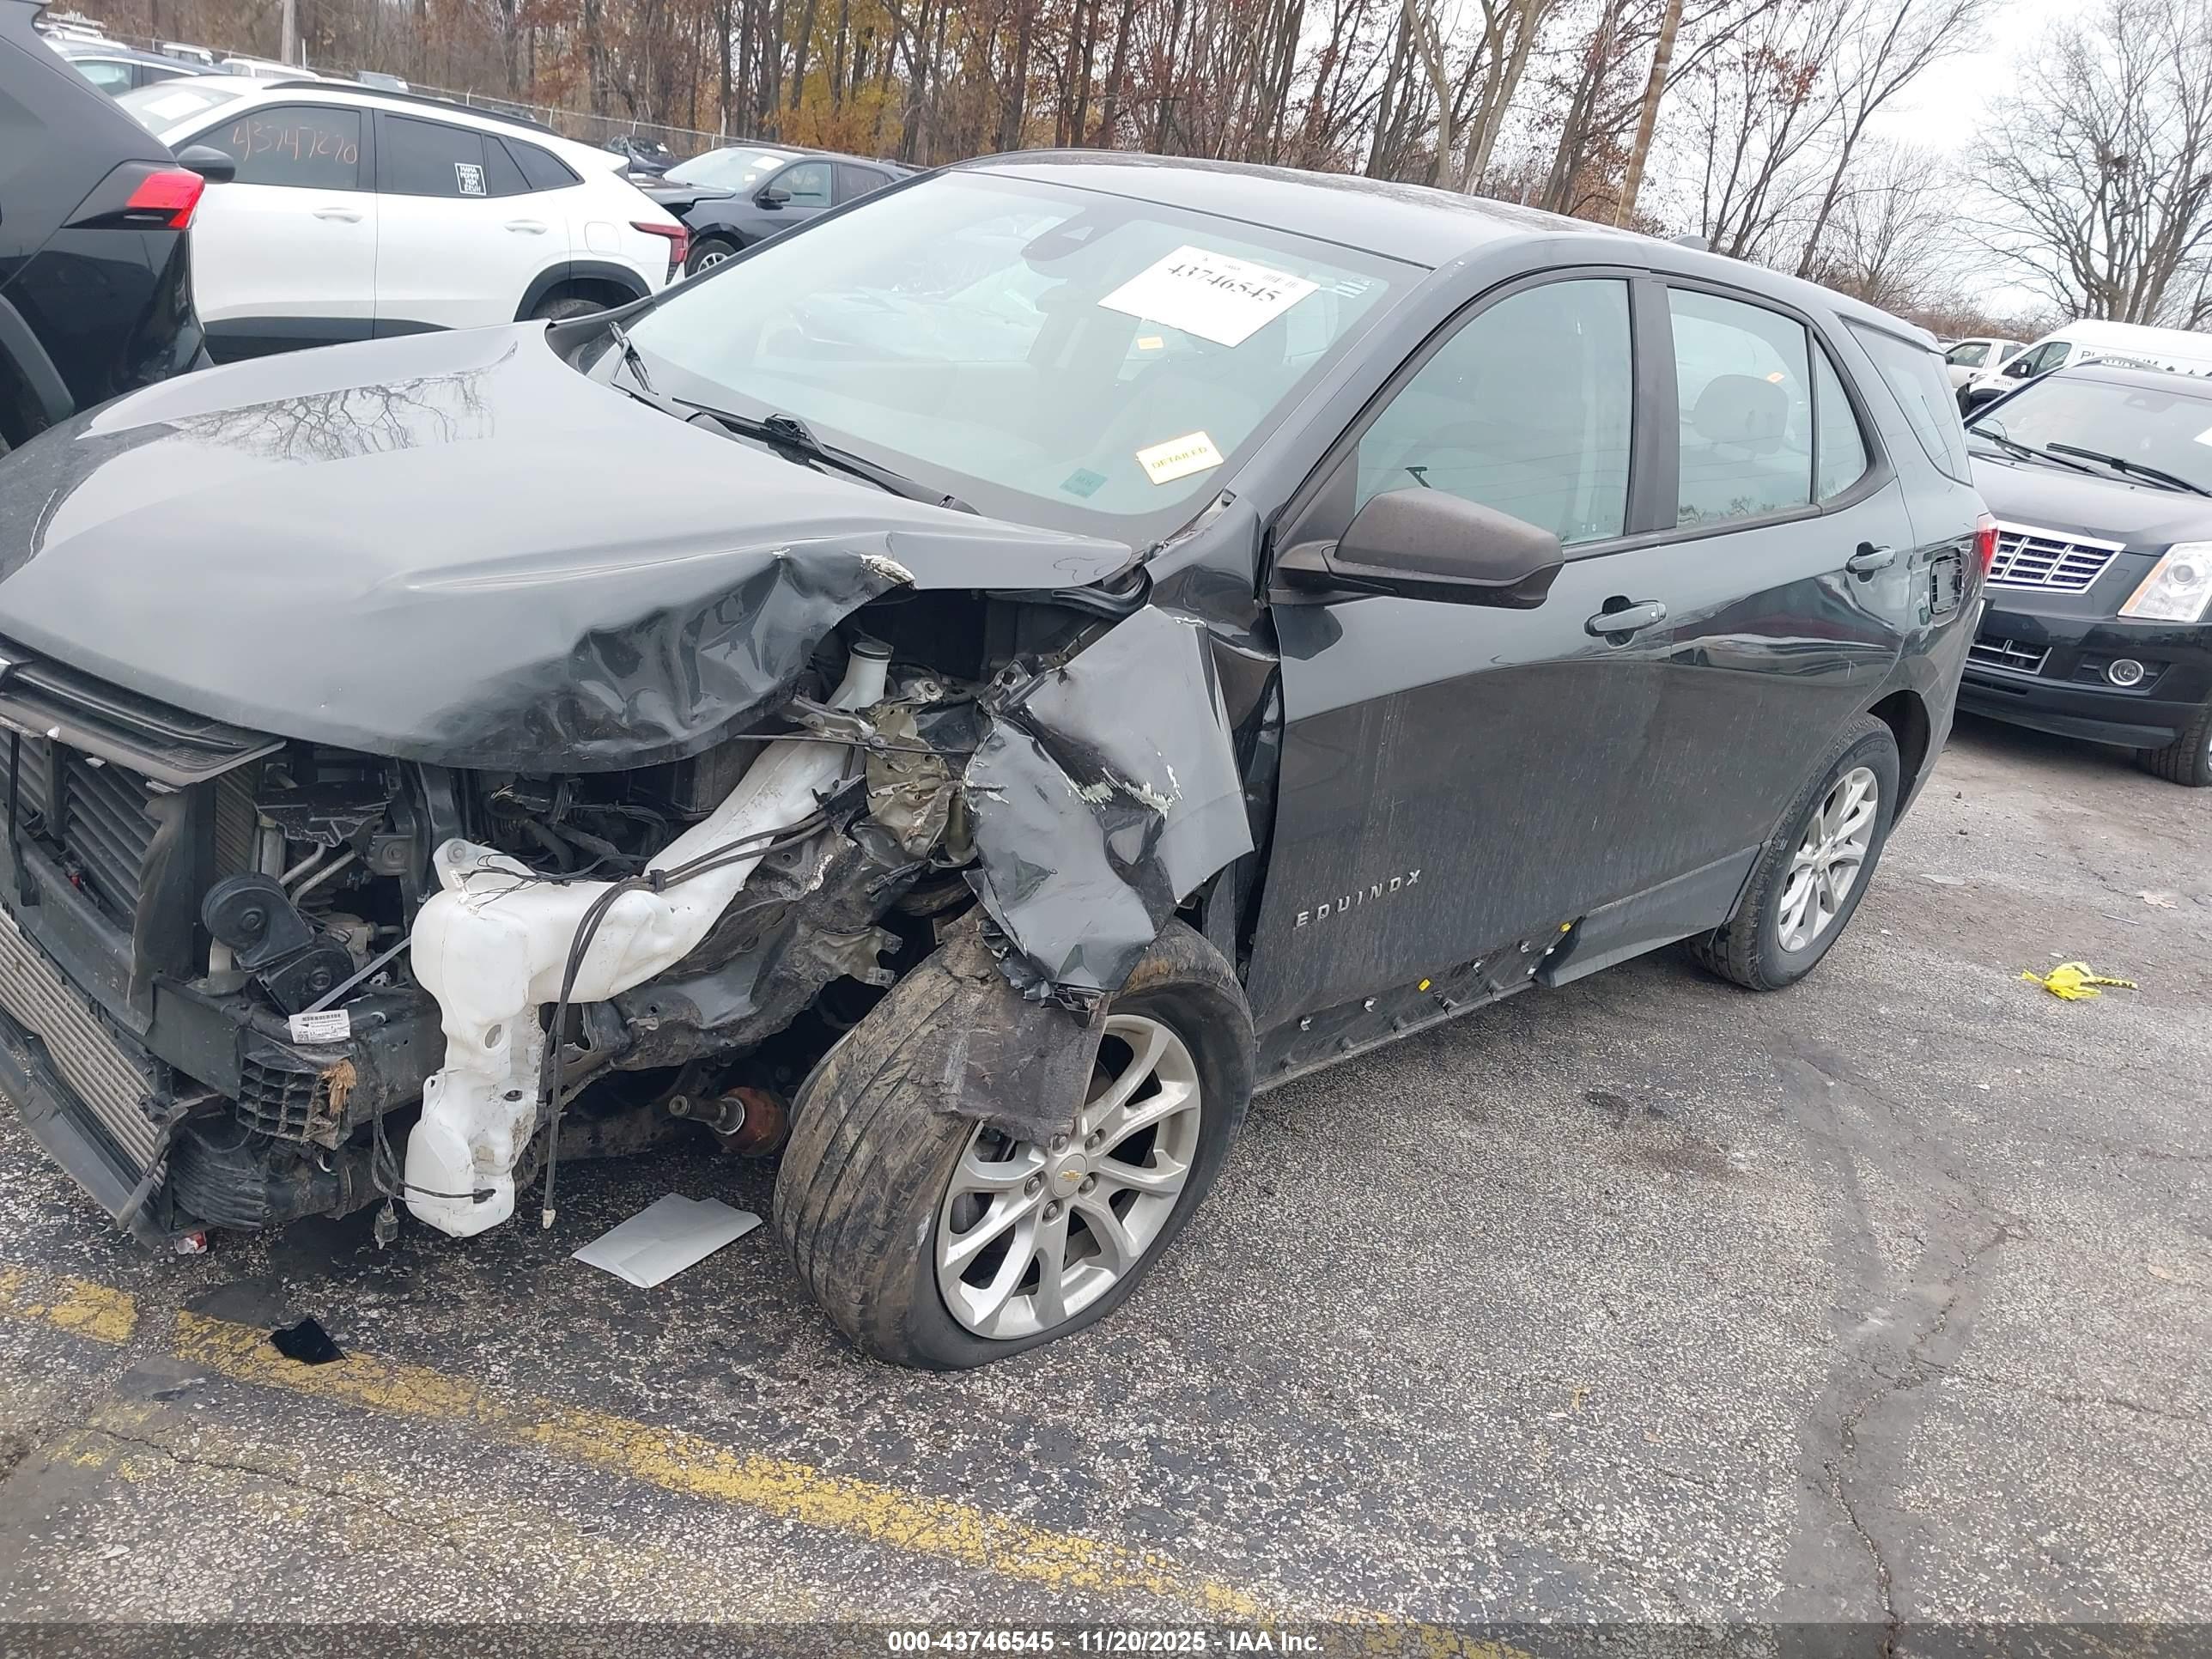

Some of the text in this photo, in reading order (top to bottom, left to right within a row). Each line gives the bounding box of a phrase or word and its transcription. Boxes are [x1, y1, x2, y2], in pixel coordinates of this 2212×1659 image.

[233, 119, 357, 165] 43747270
[1168, 264, 1282, 301] 43746545
[1152, 447, 1207, 469] DETAILED
[1293, 869, 1421, 931] EQUINOX
